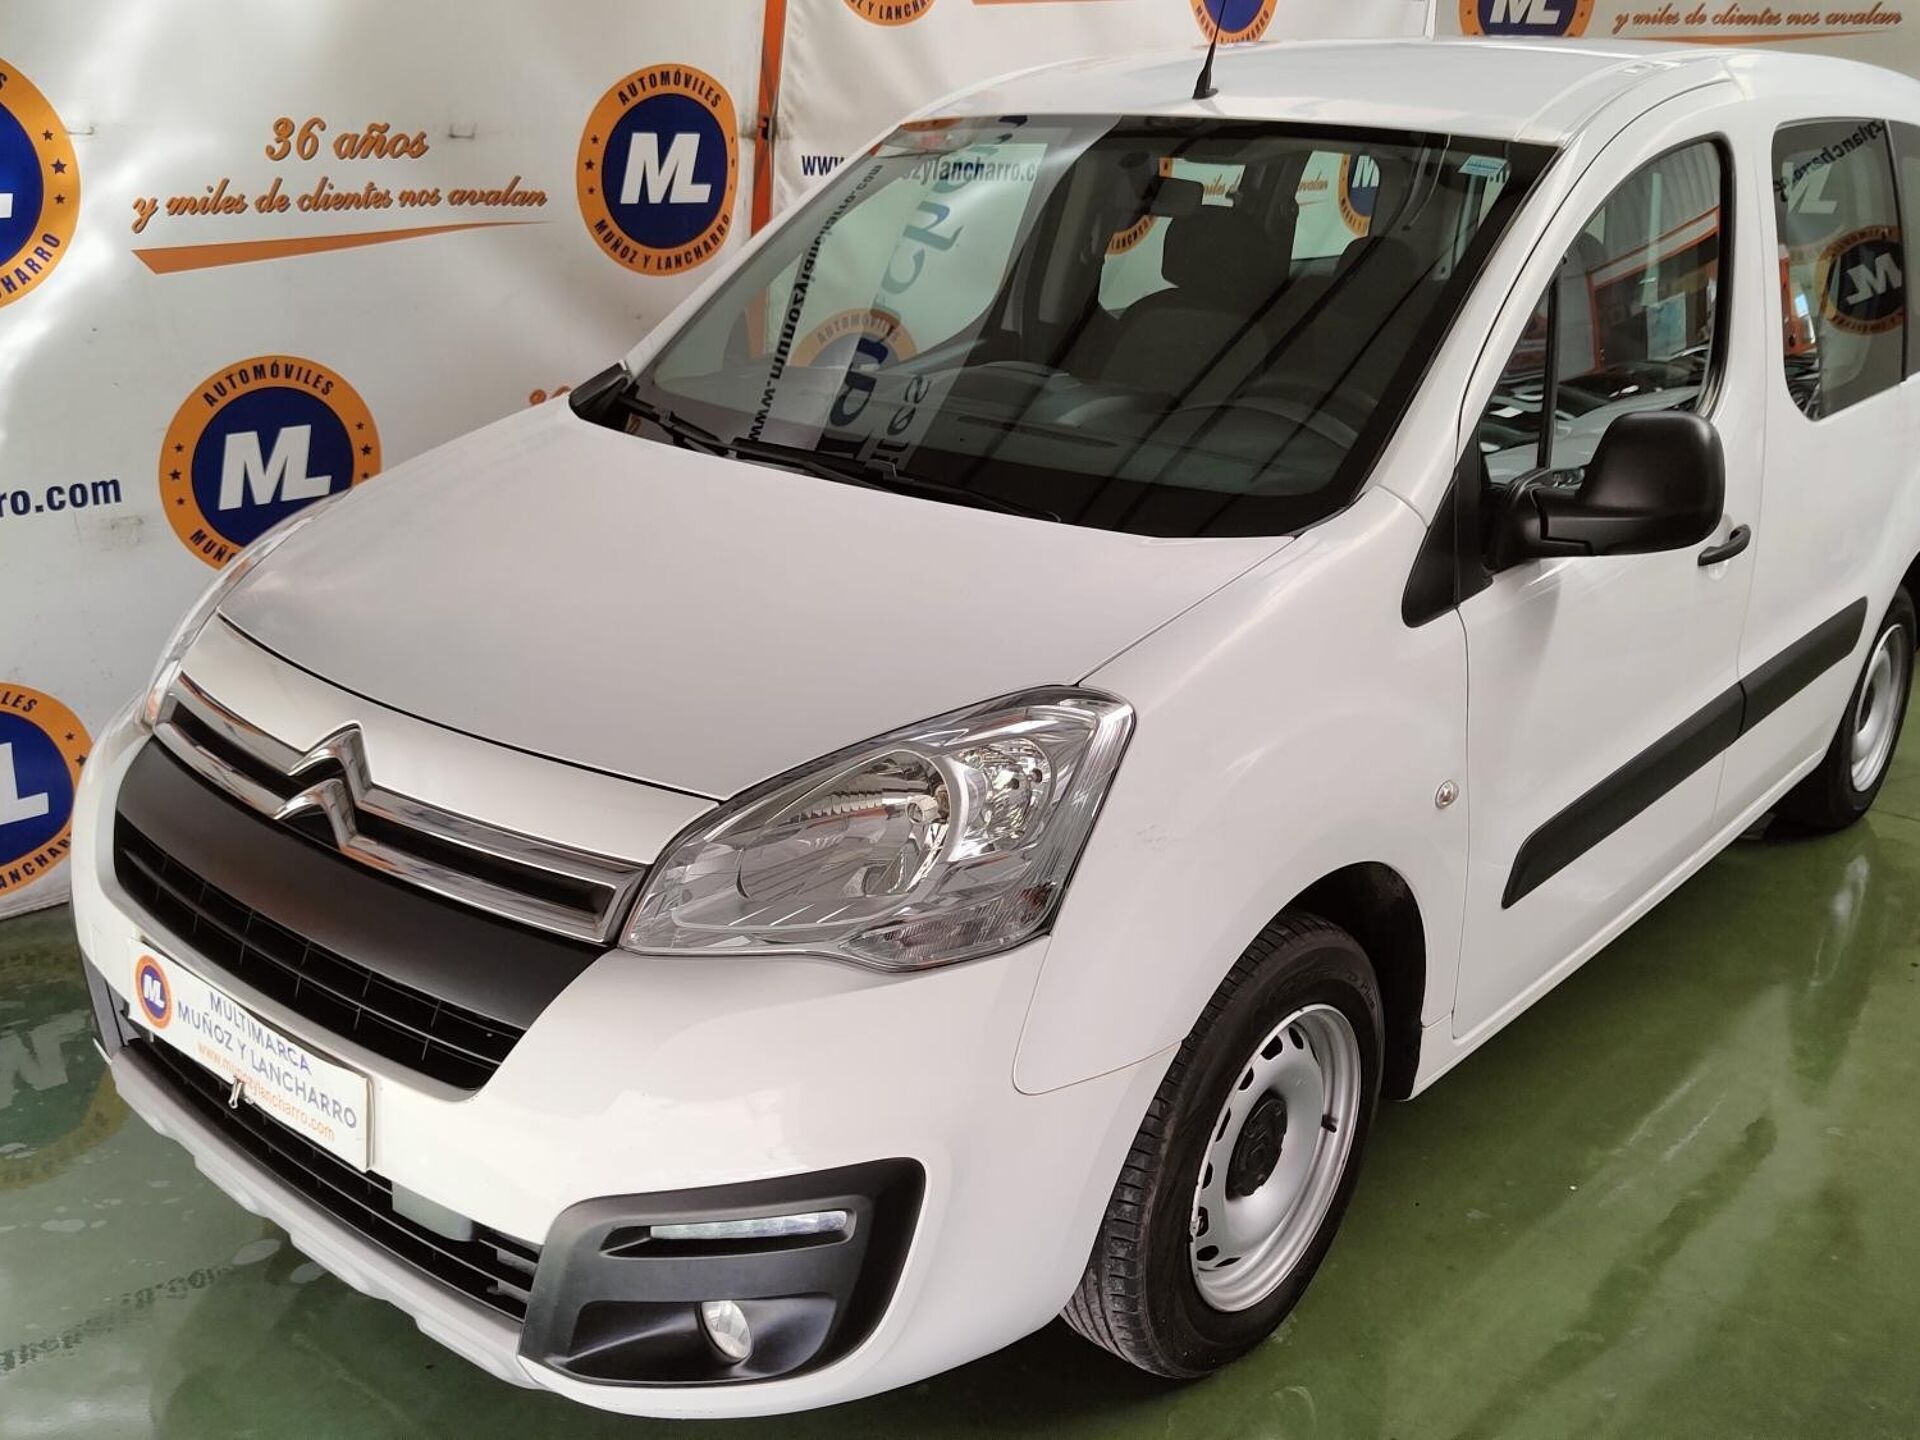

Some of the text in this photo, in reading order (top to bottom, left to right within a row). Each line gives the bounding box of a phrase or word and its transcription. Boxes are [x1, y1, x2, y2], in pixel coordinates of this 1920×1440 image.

[1612, 1, 1902, 35] y miles de clientes nos avalan
[617, 68, 722, 107] AUTOMÓVILES
[265, 117, 429, 161] 36 años
[620, 132, 711, 204] ML
[131, 175, 548, 234] y miles de clientes nos avalan
[0, 233, 60, 297] HARRO
[594, 214, 730, 271] MUÑOZ Y LANCHARRO
[202, 359, 335, 407] AUTOMÓVILES
[218, 424, 332, 511] ML
[143, 973, 165, 1008] ML
[209, 991, 312, 1075] MULTIMARCA
[177, 1000, 357, 1129] MUÑOZ Y LANCHARRO
